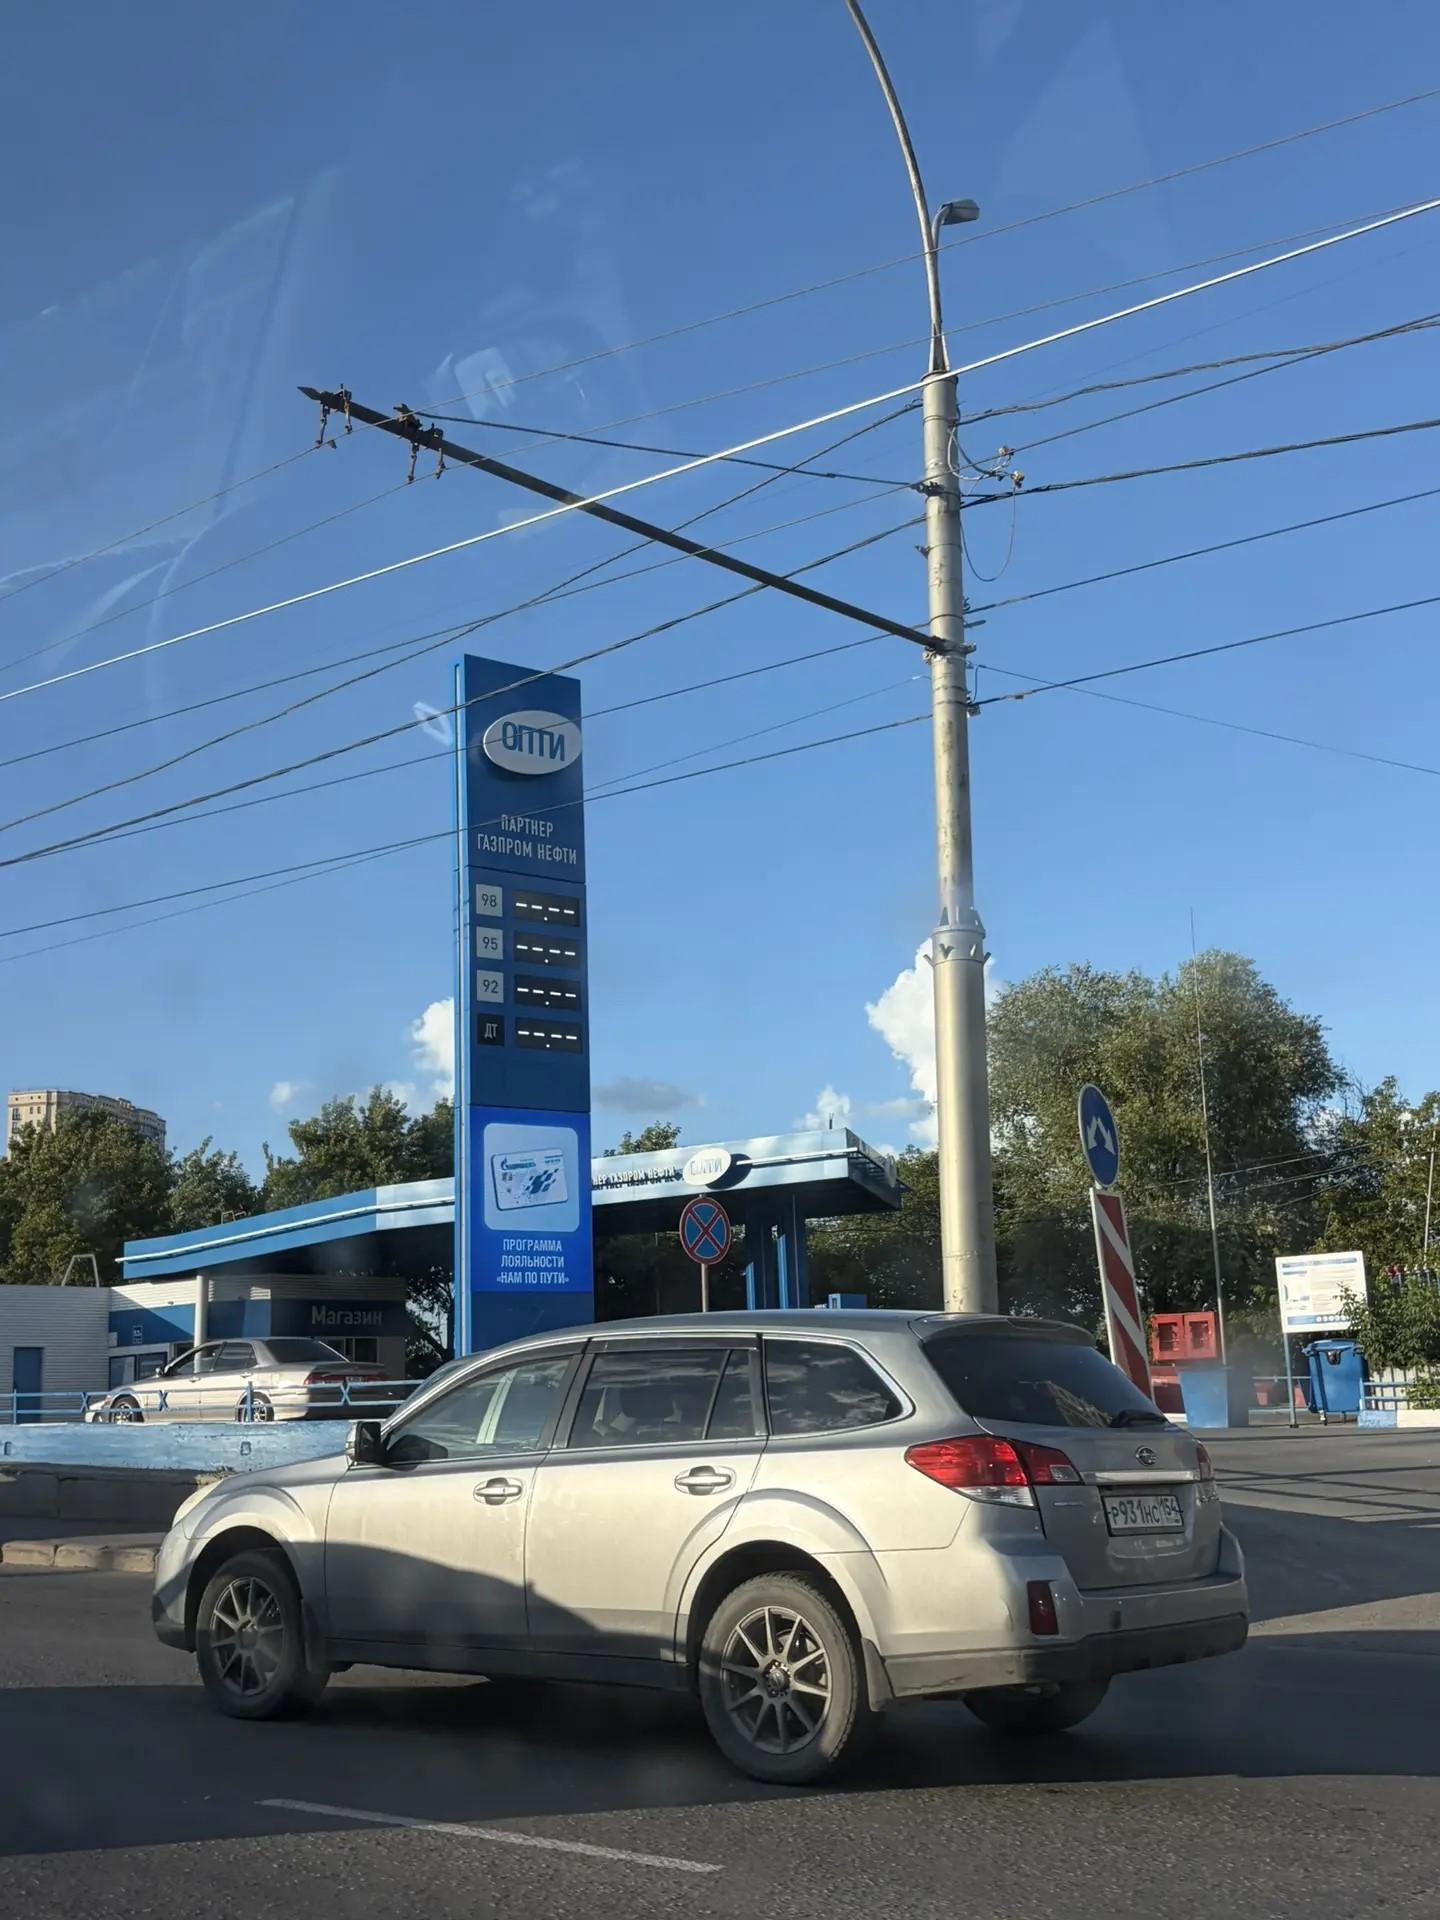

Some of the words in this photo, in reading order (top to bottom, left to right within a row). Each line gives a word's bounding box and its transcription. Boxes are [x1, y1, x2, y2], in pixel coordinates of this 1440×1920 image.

[502, 721, 565, 762] ОПТИ
[501, 814, 553, 837] ПАРТНЕР
[477, 834, 532, 858] ГАЗПРОМ
[538, 845, 577, 864] НЕФТИ
[481, 893, 497, 908] 98
[482, 936, 498, 950] 95
[482, 979, 499, 994] 92
[484, 1023, 498, 1039] ДТ
[503, 1238, 562, 1252] ПРОГРАММА
[501, 1254, 565, 1268] ЛОЯЛЬНОСТИ
[524, 1271, 538, 1284] ПО
[311, 1305, 382, 1325] Магазин
